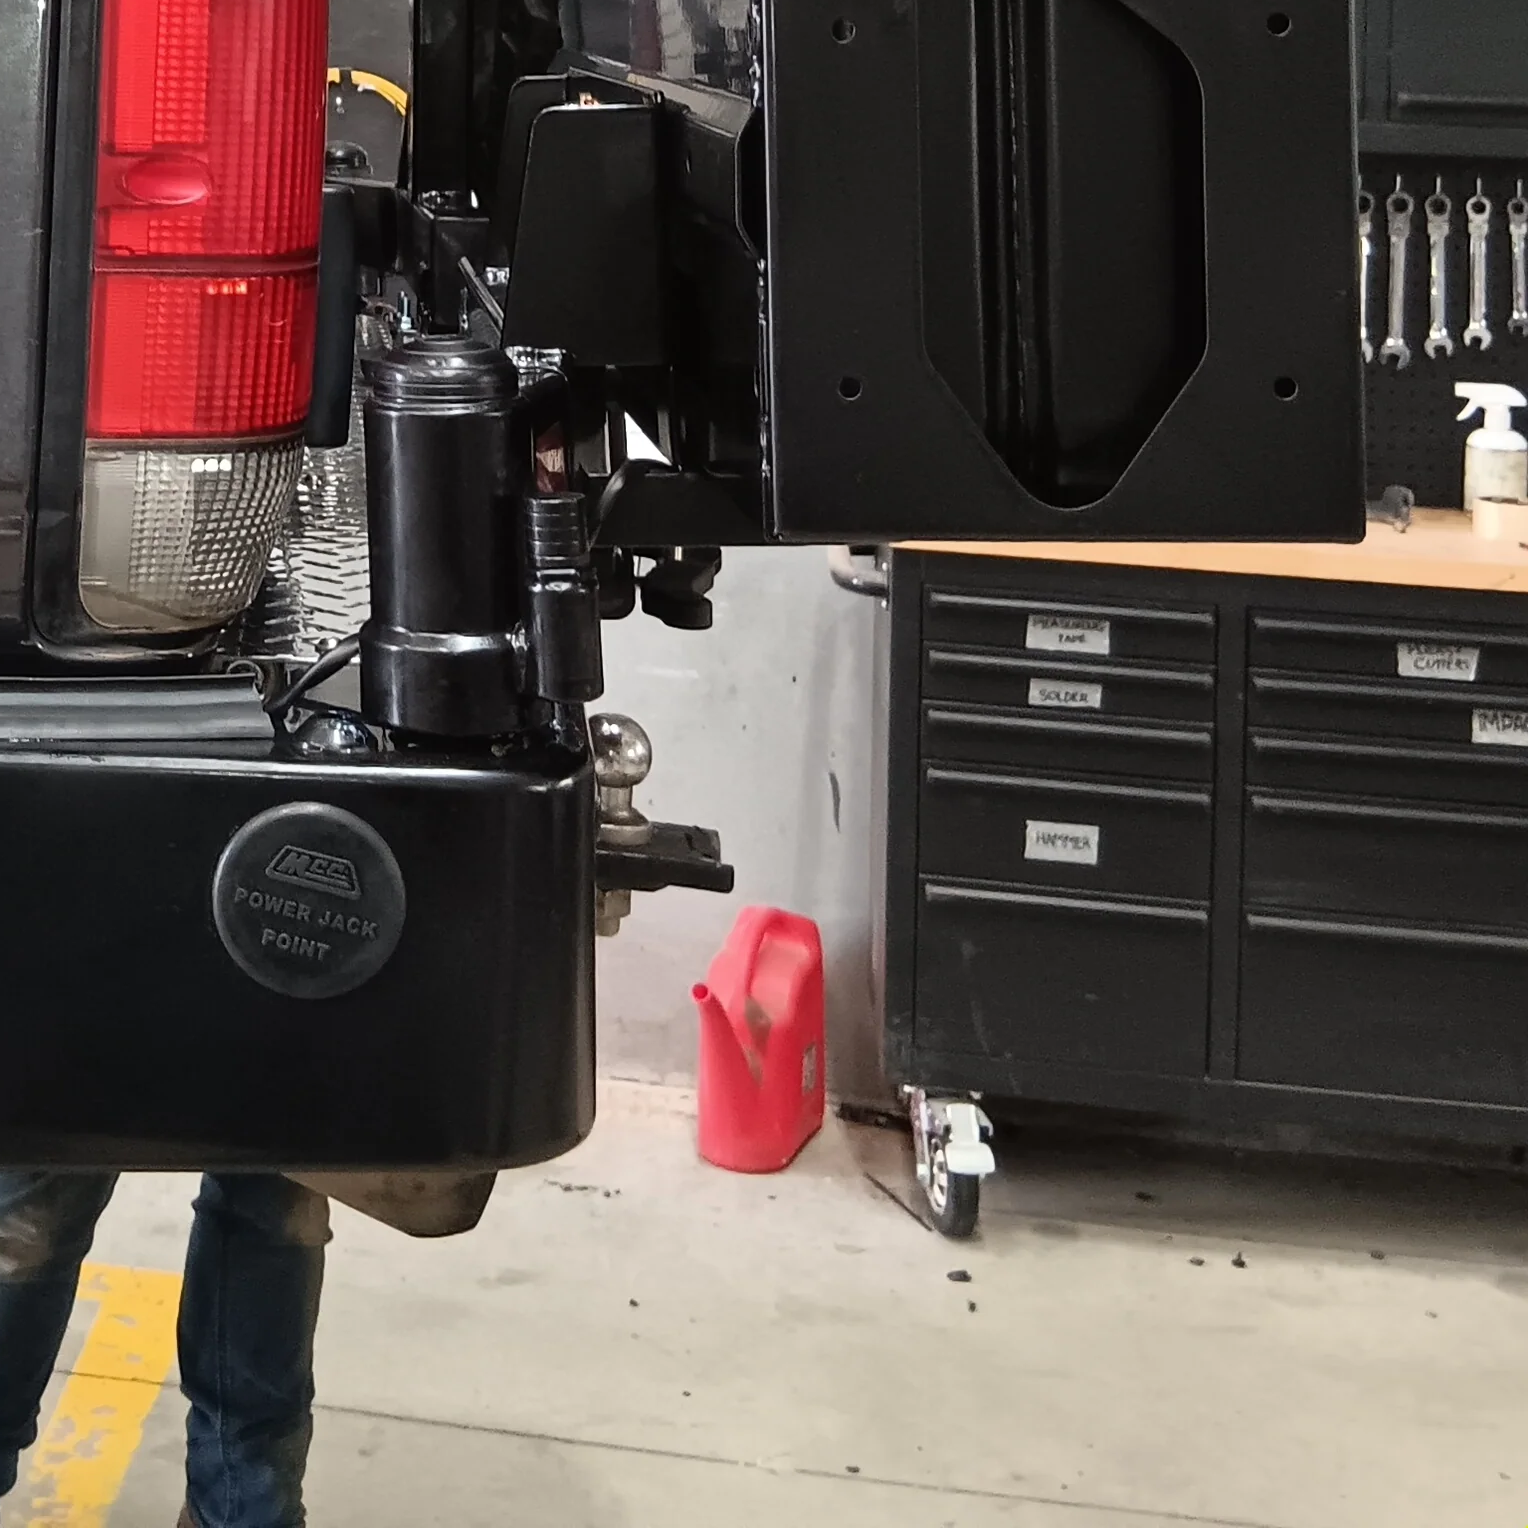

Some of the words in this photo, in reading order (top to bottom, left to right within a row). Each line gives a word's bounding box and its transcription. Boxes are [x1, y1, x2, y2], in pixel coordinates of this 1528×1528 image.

[1039, 688, 1089, 703] SOLDER
[1036, 831, 1091, 849] HAMMER
[234, 887, 311, 923] POWER
[318, 910, 381, 940] JACK
[261, 928, 331, 961] POINT
